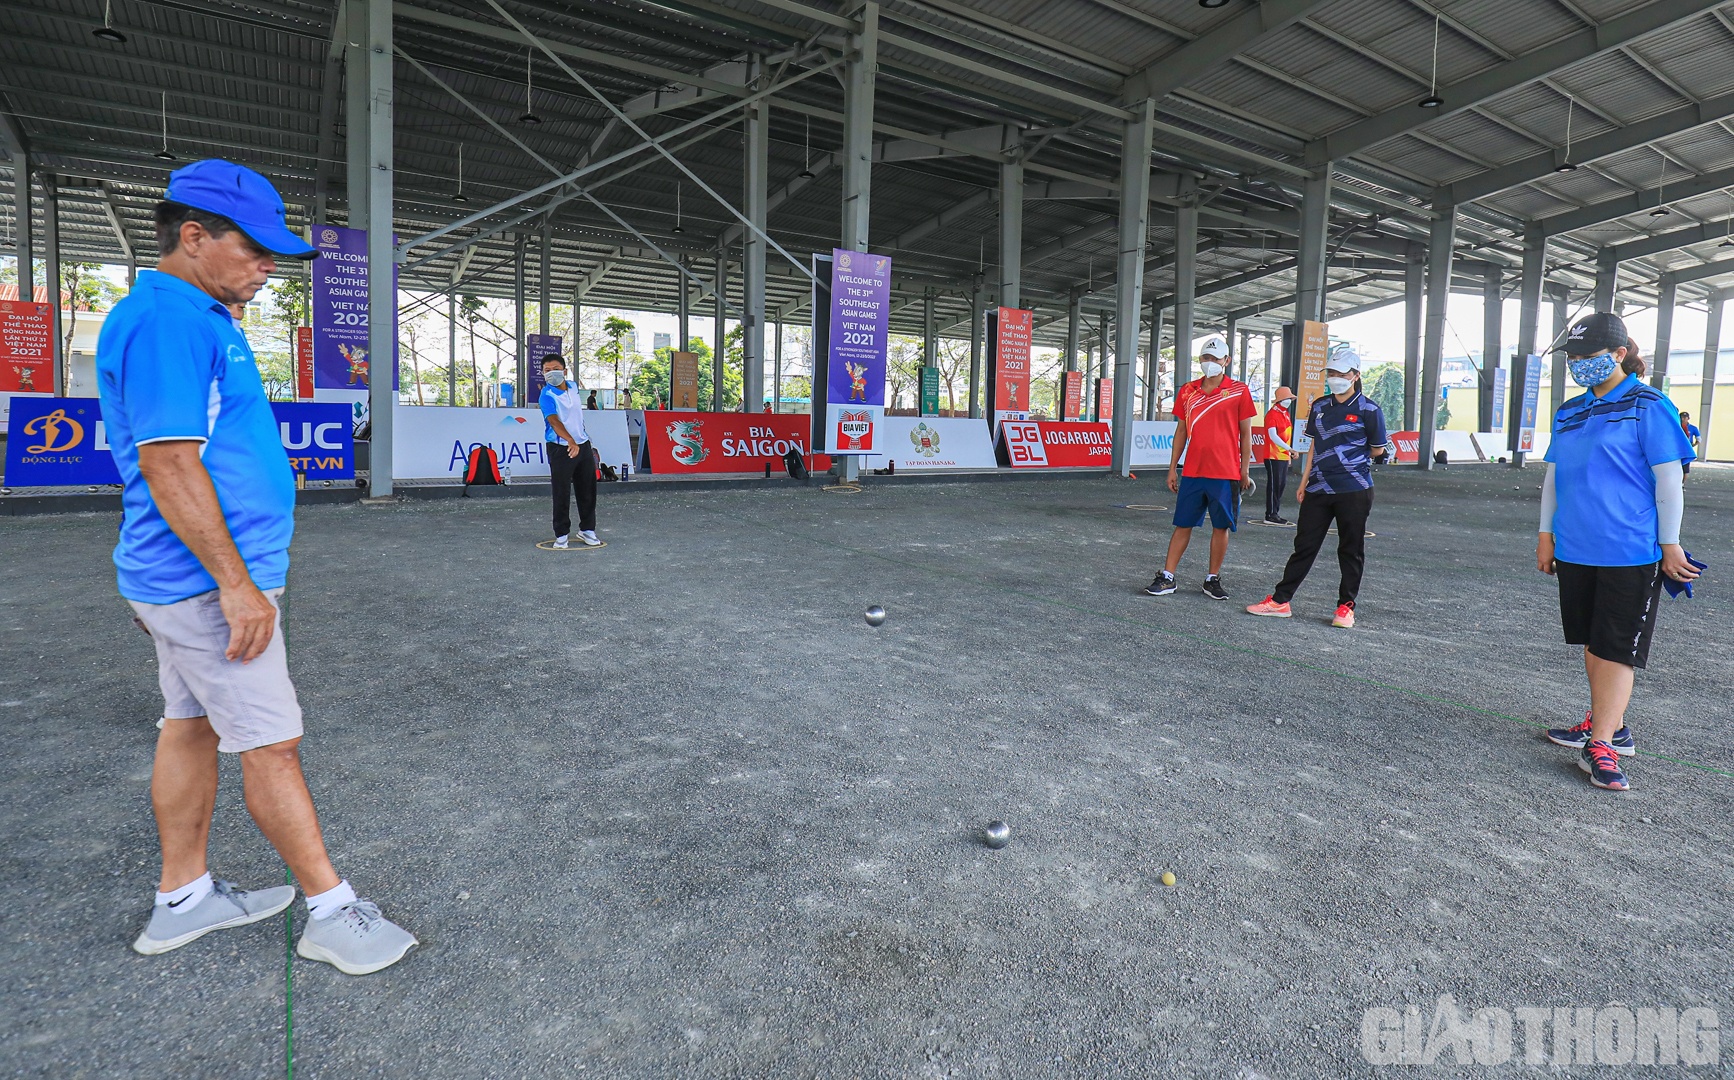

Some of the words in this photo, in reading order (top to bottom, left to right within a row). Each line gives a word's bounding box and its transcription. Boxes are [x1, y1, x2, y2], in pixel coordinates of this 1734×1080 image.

[336, 265, 356, 274] THE
[838, 274, 872, 286] WELCOME
[329, 288, 352, 296] ASIAN
[355, 289, 368, 298] GA
[847, 288, 861, 296] THE
[331, 301, 354, 310] VIET
[839, 298, 880, 309] SOUTHEAST
[842, 309, 858, 318] ASIAN
[859, 311, 877, 320] GAMES
[842, 322, 858, 330] VIET
[860, 324, 876, 332] NAM
[844, 332, 874, 346] 2021
[10, 348, 42, 356] 2021
[1005, 361, 1024, 370] 2021
[1306, 372, 1320, 380] 2021
[749, 426, 775, 438] BIA
[844, 424, 854, 432] BIA
[855, 422, 868, 433] VIỆT
[1010, 426, 1039, 442] JG
[1045, 431, 1112, 444] JOGARBOLA
[721, 438, 805, 457] SAIGON
[1012, 445, 1044, 461] BL
[22, 455, 56, 464] ĐỘNG
